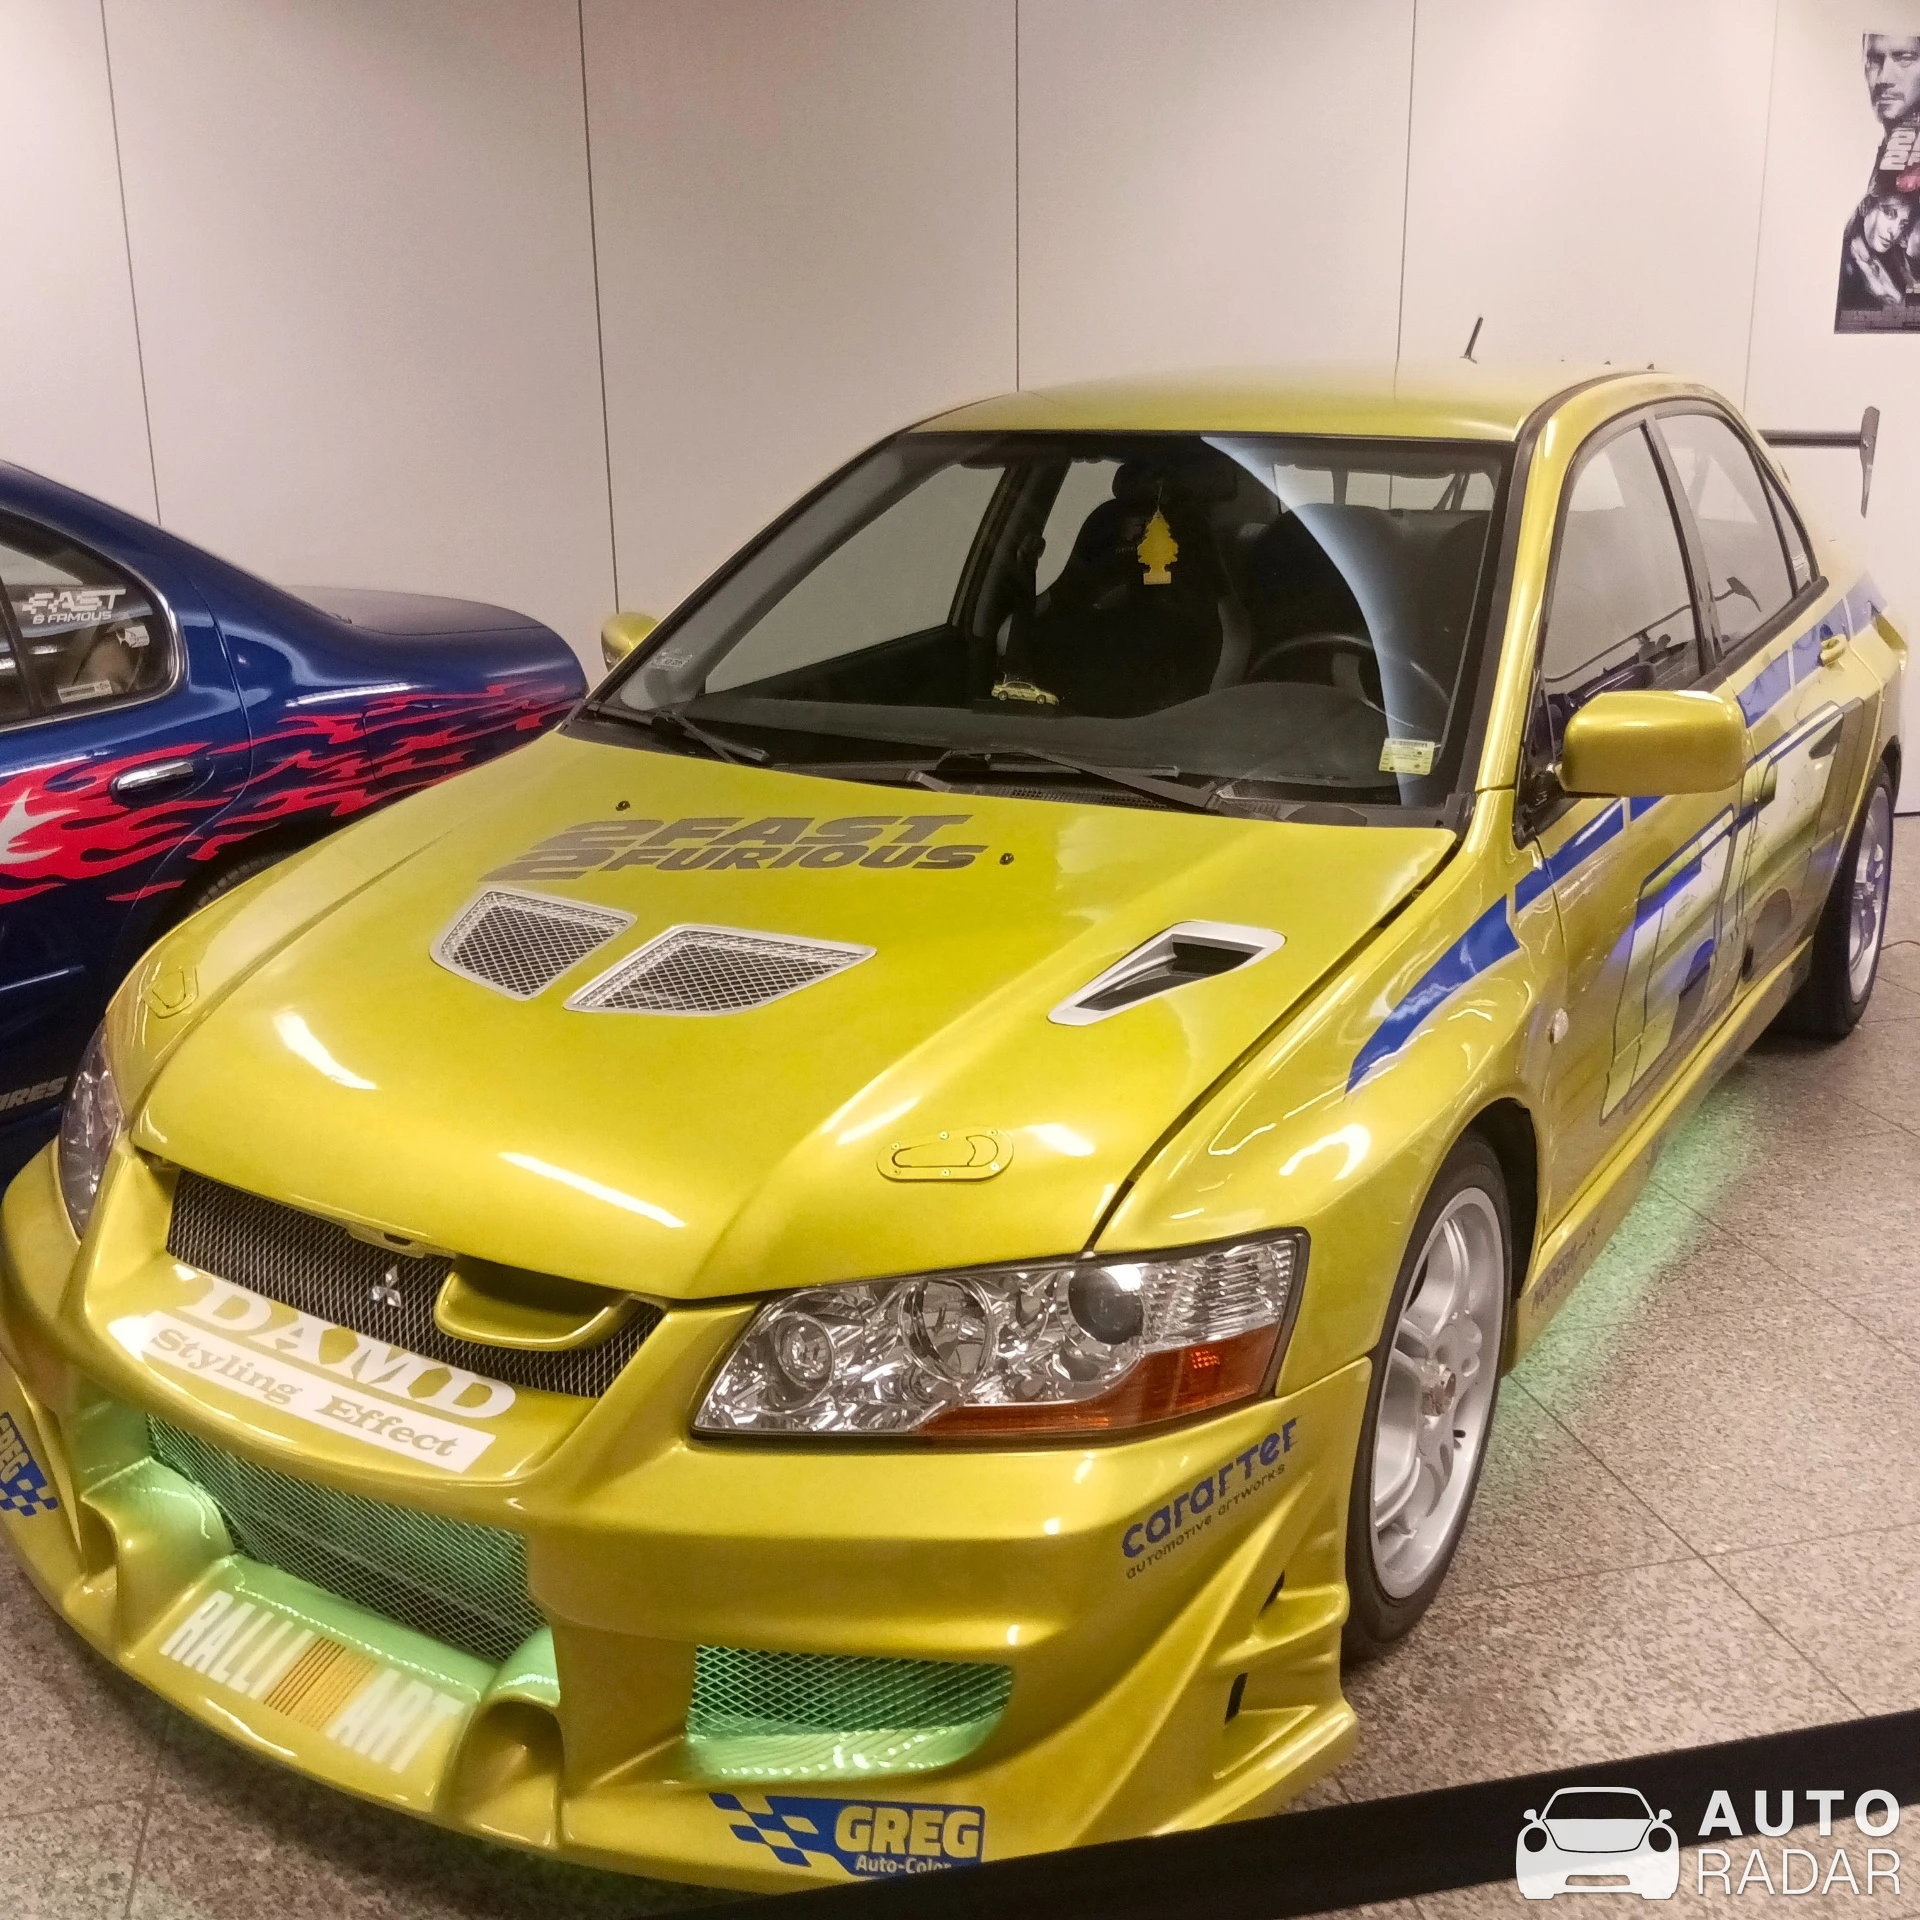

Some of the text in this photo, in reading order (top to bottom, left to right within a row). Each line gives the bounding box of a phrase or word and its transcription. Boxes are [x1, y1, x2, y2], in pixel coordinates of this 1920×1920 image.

[22, 588, 126, 614] FAST
[48, 611, 112, 624] FAMOUS
[179, 1276, 516, 1419] DAMD
[151, 1328, 460, 1457] Styling Effect
[0, 1416, 29, 1485] REG
[1126, 1463, 1286, 1580] automotive artworks
[834, 1805, 980, 1858] GREG
